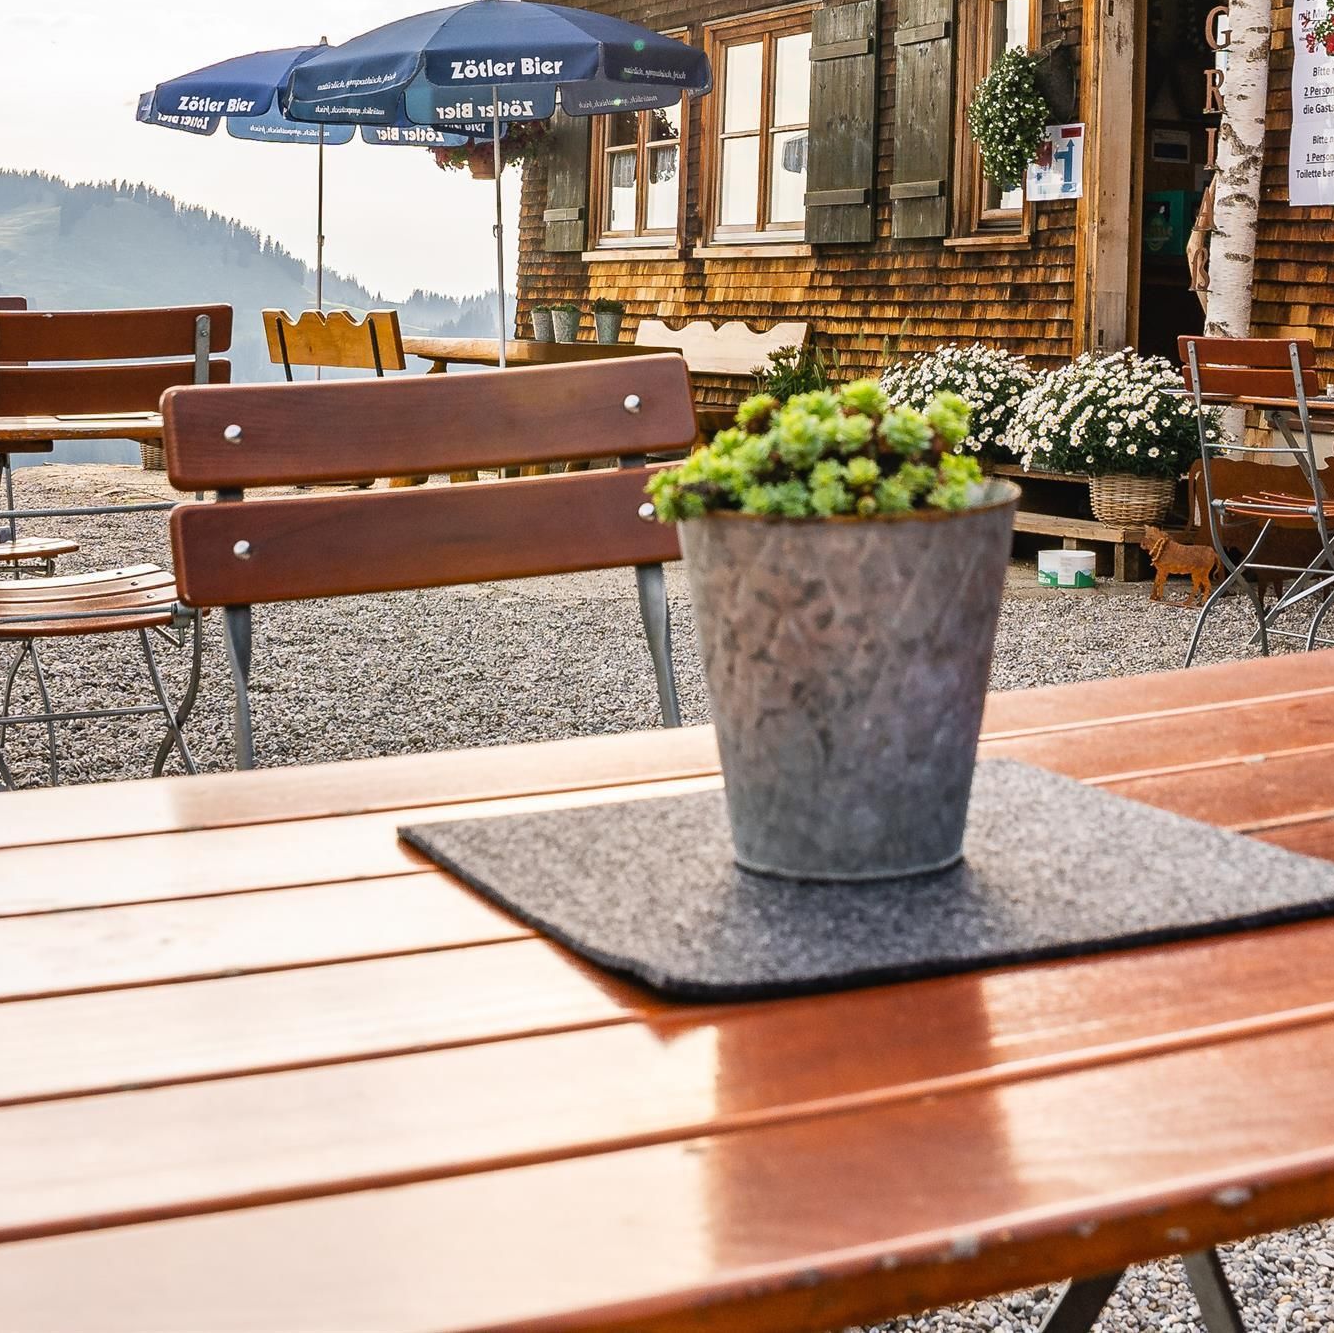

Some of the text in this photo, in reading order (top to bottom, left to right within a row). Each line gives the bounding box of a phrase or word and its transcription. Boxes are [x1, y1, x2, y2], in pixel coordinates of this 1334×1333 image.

[450, 56, 563, 80] Zötler Bier
[1312, 66, 1331, 77] Bitte
[1304, 86, 1309, 97] 2
[177, 96, 255, 113] Zötler Bier
[1303, 104, 1314, 115] die
[1312, 135, 1328, 144] Bitte
[1306, 153, 1310, 162] 1
[1311, 152, 1334, 162] Person
[1296, 169, 1322, 179] Toilette
